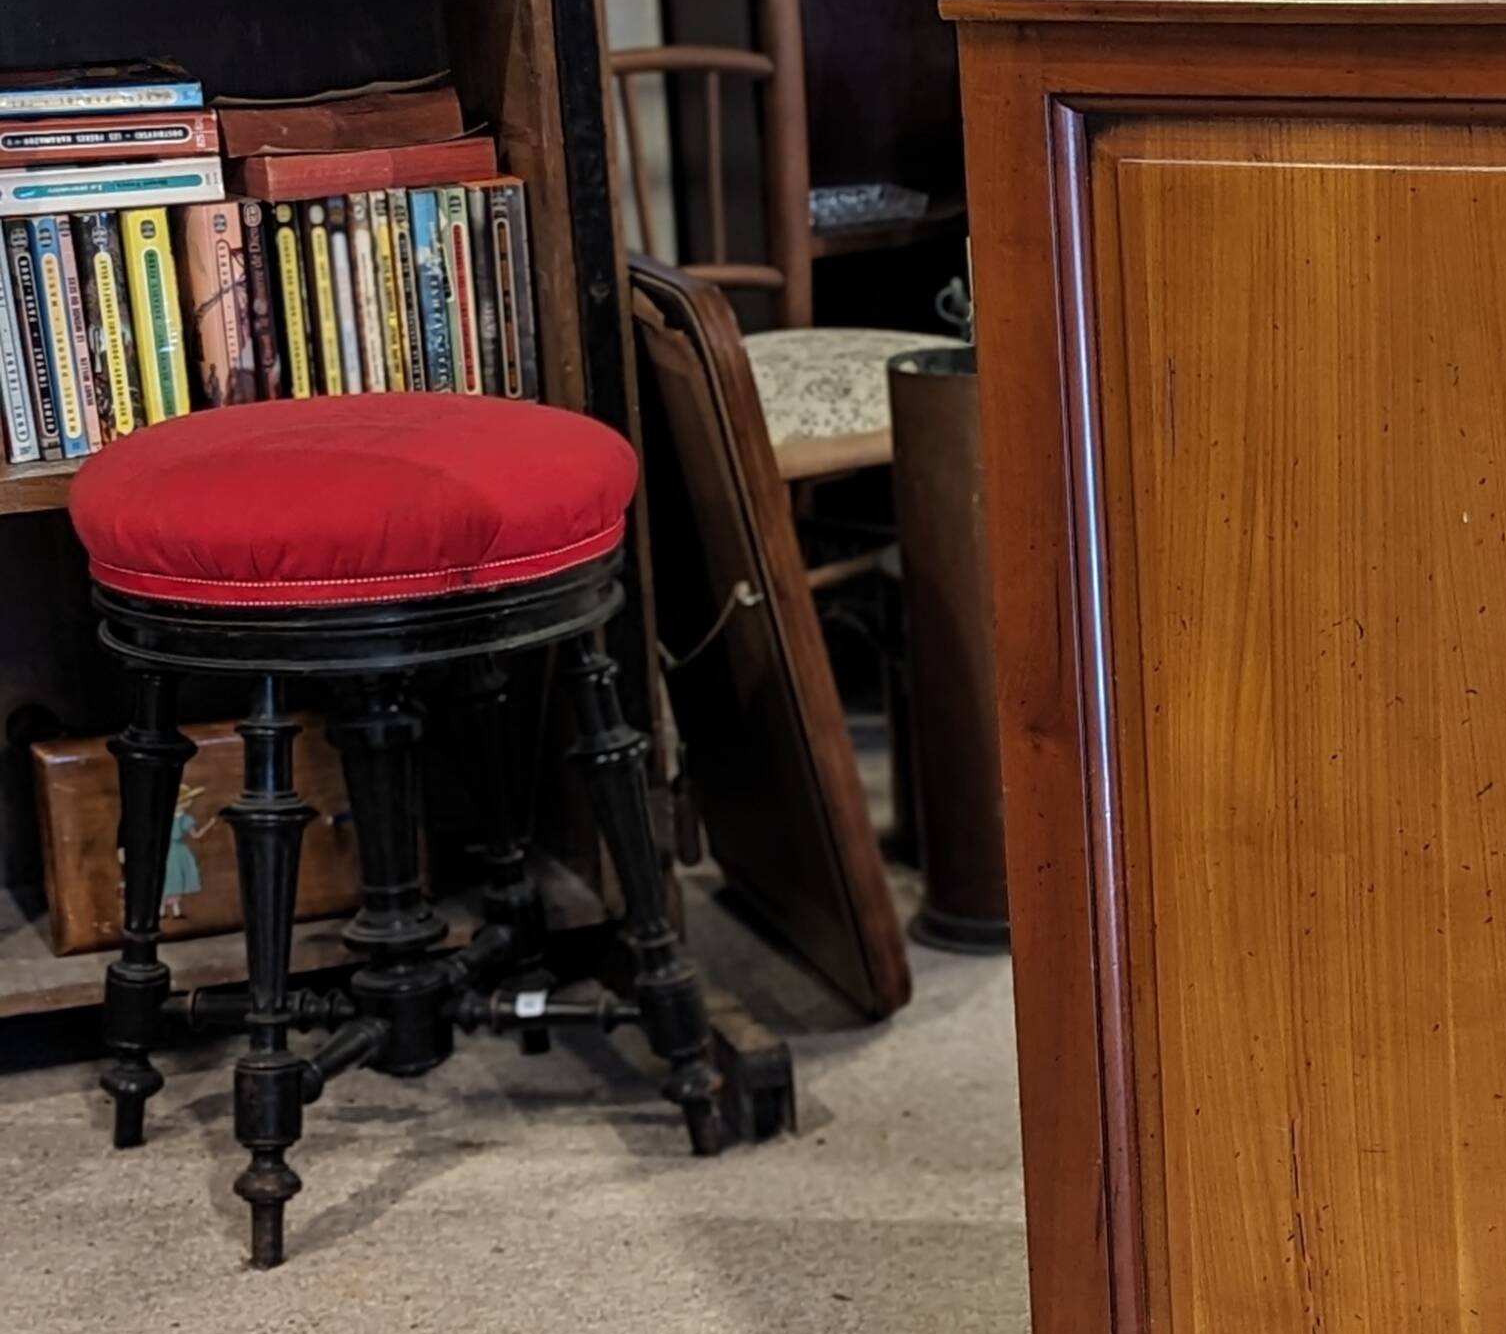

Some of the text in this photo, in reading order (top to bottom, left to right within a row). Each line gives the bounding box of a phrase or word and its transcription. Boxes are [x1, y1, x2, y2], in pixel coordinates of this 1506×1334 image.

[246, 226, 261, 253] Dieu
[67, 275, 77, 294] SEXE
[71, 306, 83, 333] MONDE
[79, 356, 90, 382] MILLER
[4, 350, 26, 436] ANNE FRANK
[83, 383, 94, 406] HENRY
[62, 385, 77, 432] MARCEL
